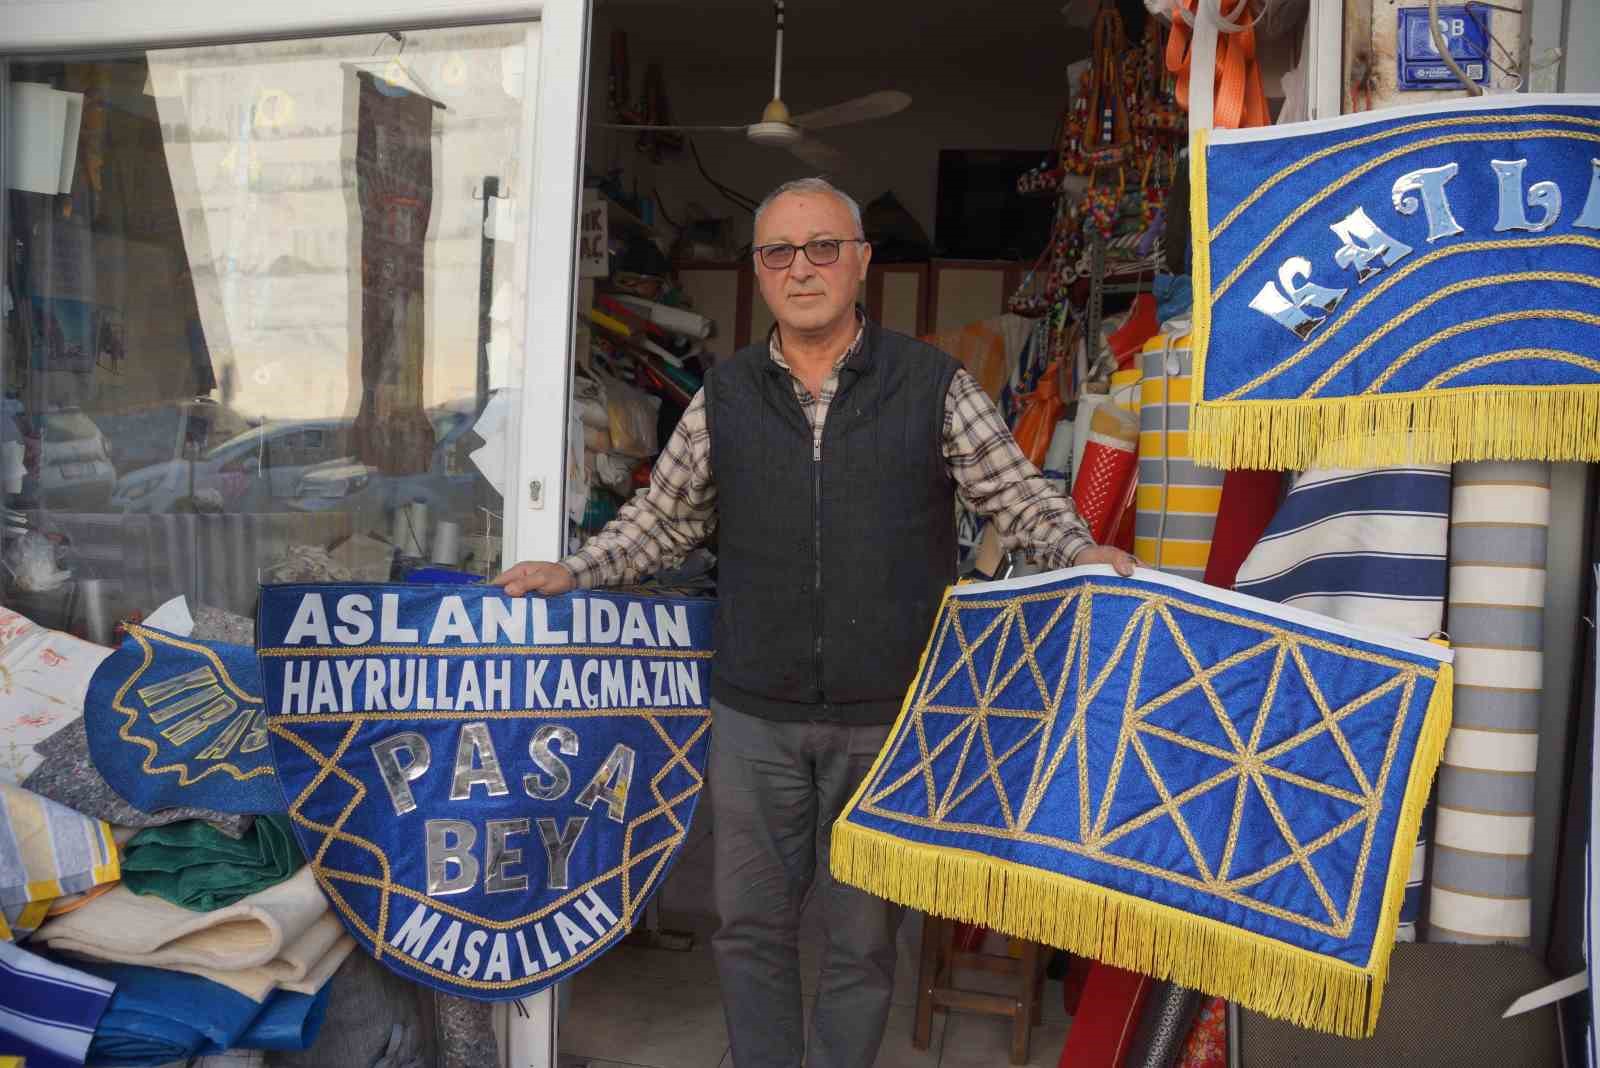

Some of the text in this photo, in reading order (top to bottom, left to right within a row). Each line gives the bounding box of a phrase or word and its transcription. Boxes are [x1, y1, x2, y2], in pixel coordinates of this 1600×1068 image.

[281, 658, 703, 714] HAYRULLAH KAÇMAZIN
[369, 721, 637, 824] PASA
[424, 816, 589, 897] BEY
[390, 888, 620, 982] MAŞALLAH
